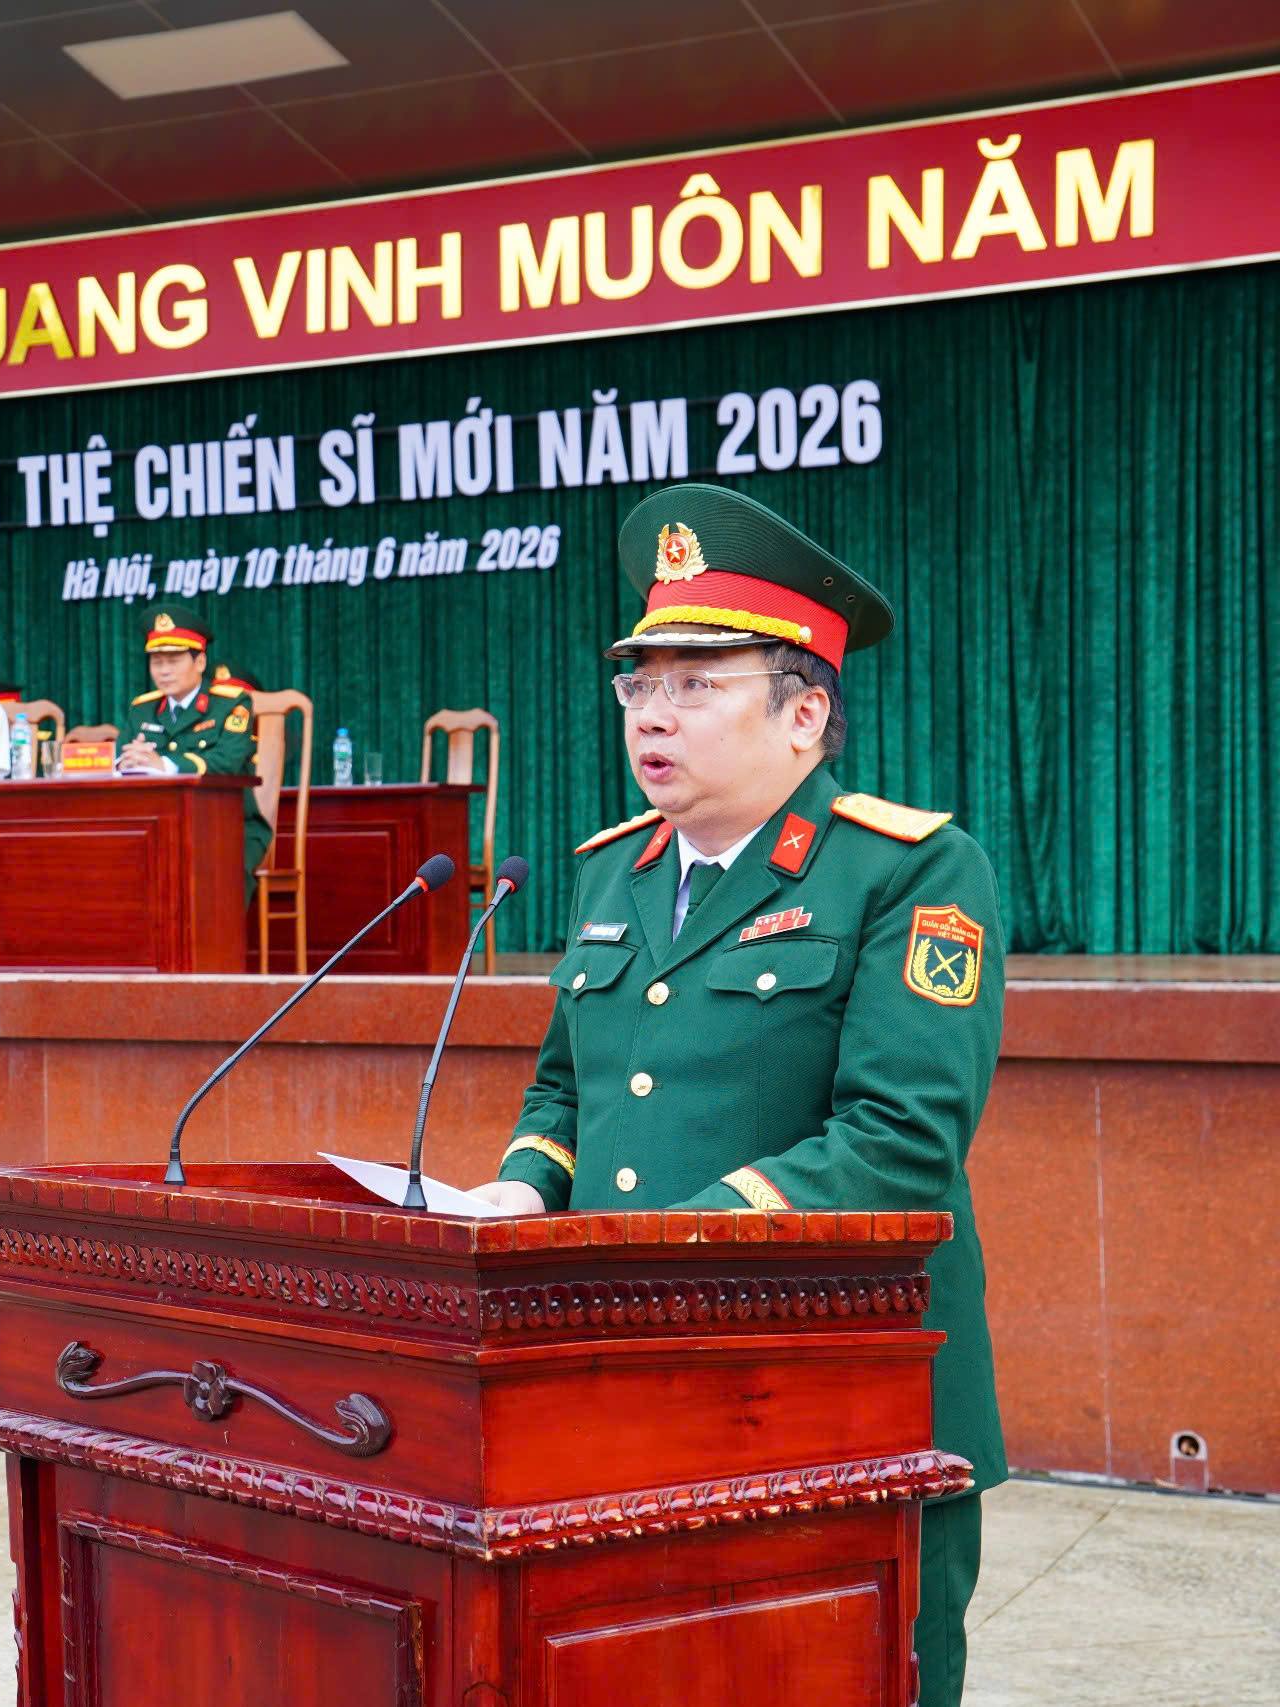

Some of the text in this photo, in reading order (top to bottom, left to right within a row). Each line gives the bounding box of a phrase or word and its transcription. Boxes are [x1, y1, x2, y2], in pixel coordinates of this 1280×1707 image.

[233, 231, 462, 339] VINH
[499, 172, 823, 313] MUÔN
[867, 133, 1156, 270] NĂM
[17, 434, 115, 538] THỆ
[134, 414, 296, 520] CHIẾN
[318, 412, 376, 507] SĨ
[398, 396, 514, 501] MỚI
[538, 388, 689, 489] NĂM
[716, 379, 883, 475] 2026
[62, 525, 561, 604] Hà Nội, ngày 10 tháng 6 năm 2026
